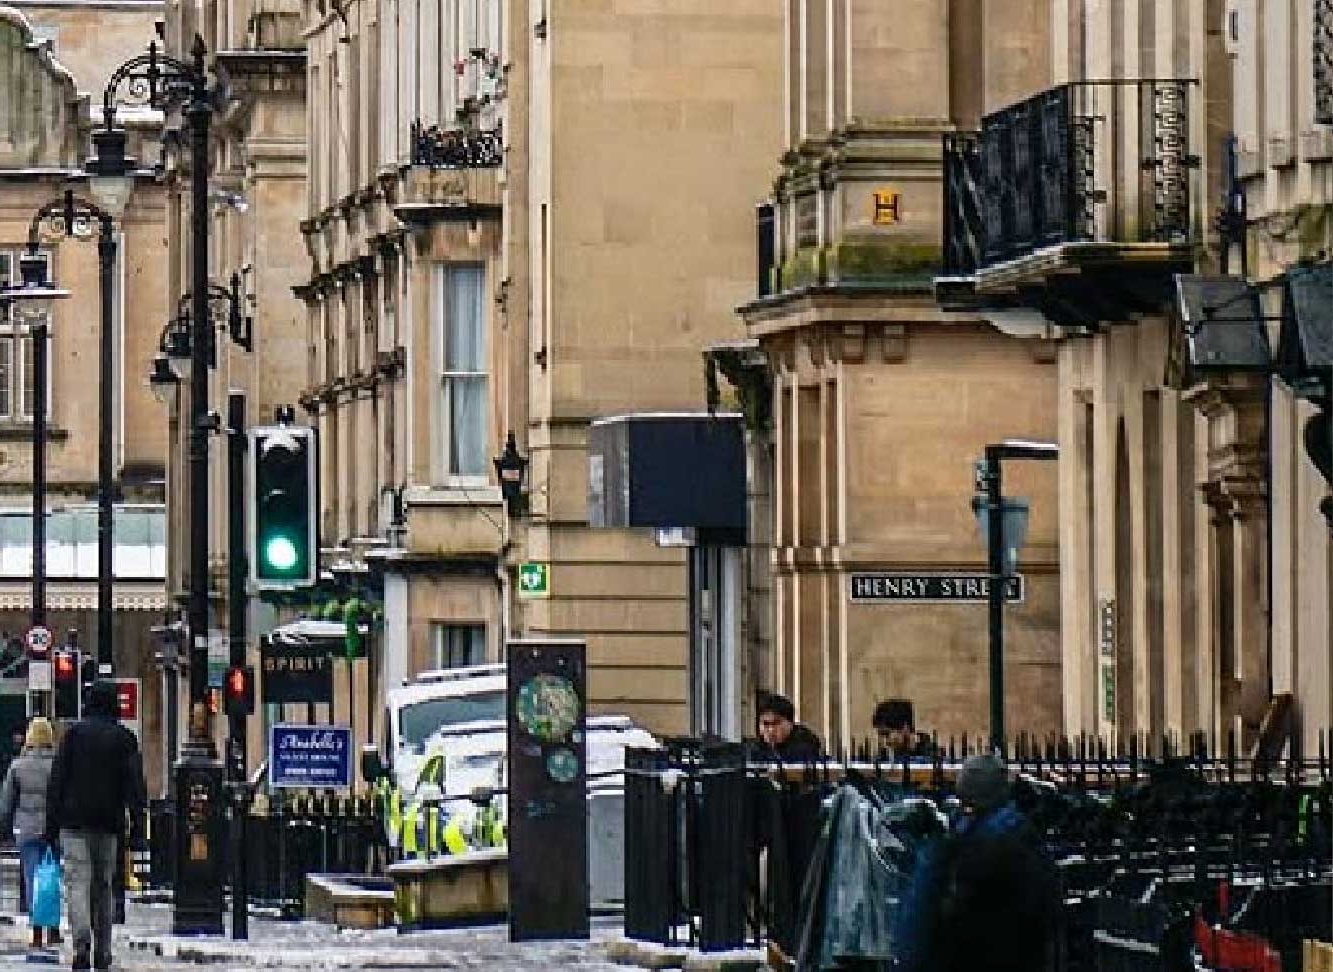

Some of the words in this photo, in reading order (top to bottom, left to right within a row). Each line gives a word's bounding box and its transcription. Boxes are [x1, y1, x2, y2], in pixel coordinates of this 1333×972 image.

[857, 577, 929, 597] HENRY
[940, 577, 1018, 597] STRET
[264, 656, 325, 671] SPIRIT
